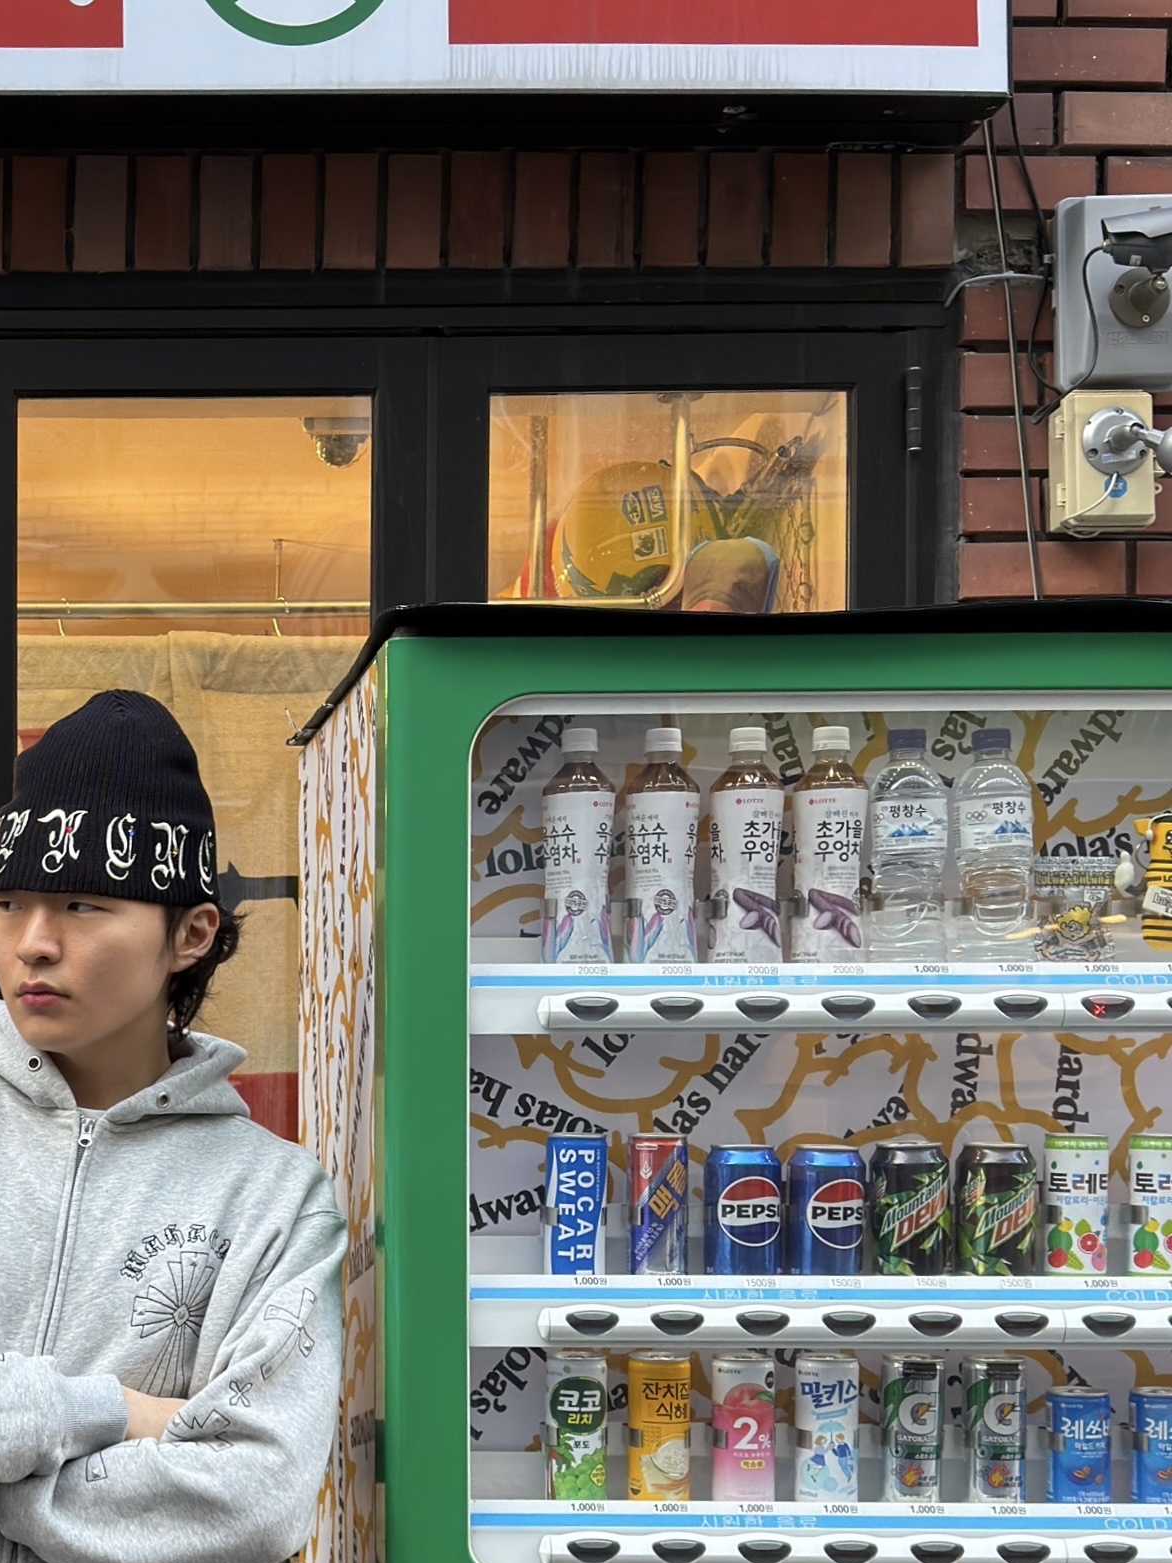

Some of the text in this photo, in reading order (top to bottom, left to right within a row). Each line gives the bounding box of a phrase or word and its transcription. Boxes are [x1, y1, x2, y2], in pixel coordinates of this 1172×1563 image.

[889, 804, 927, 818] 평창수
[991, 803, 1027, 816] 평창수
[741, 841, 778, 863] 우엉
[578, 966, 608, 975] 2000원
[662, 966, 692, 975] 2000원
[748, 966, 778, 975] 2000원
[834, 966, 864, 975] 2000원
[557, 1149, 577, 1262] SWEAT
[801, 1379, 859, 1409] 밀키스
[557, 1390, 601, 1412] 코코
[567, 1413, 593, 1425] 리치
[733, 1416, 772, 1450] 2%
[573, 1440, 590, 1449] 포도
[571, 1503, 605, 1512] 1,000원
[654, 1503, 688, 1512] 1,000원
[739, 1504, 774, 1513] 1,000원
[824, 1505, 858, 1514] 1,000원
[911, 1505, 945, 1514] 1,000원
[992, 1506, 1027, 1515] 1,000원
[1077, 1506, 1112, 1514] 1,000원
[1104, 1518, 1168, 1531] COLD
